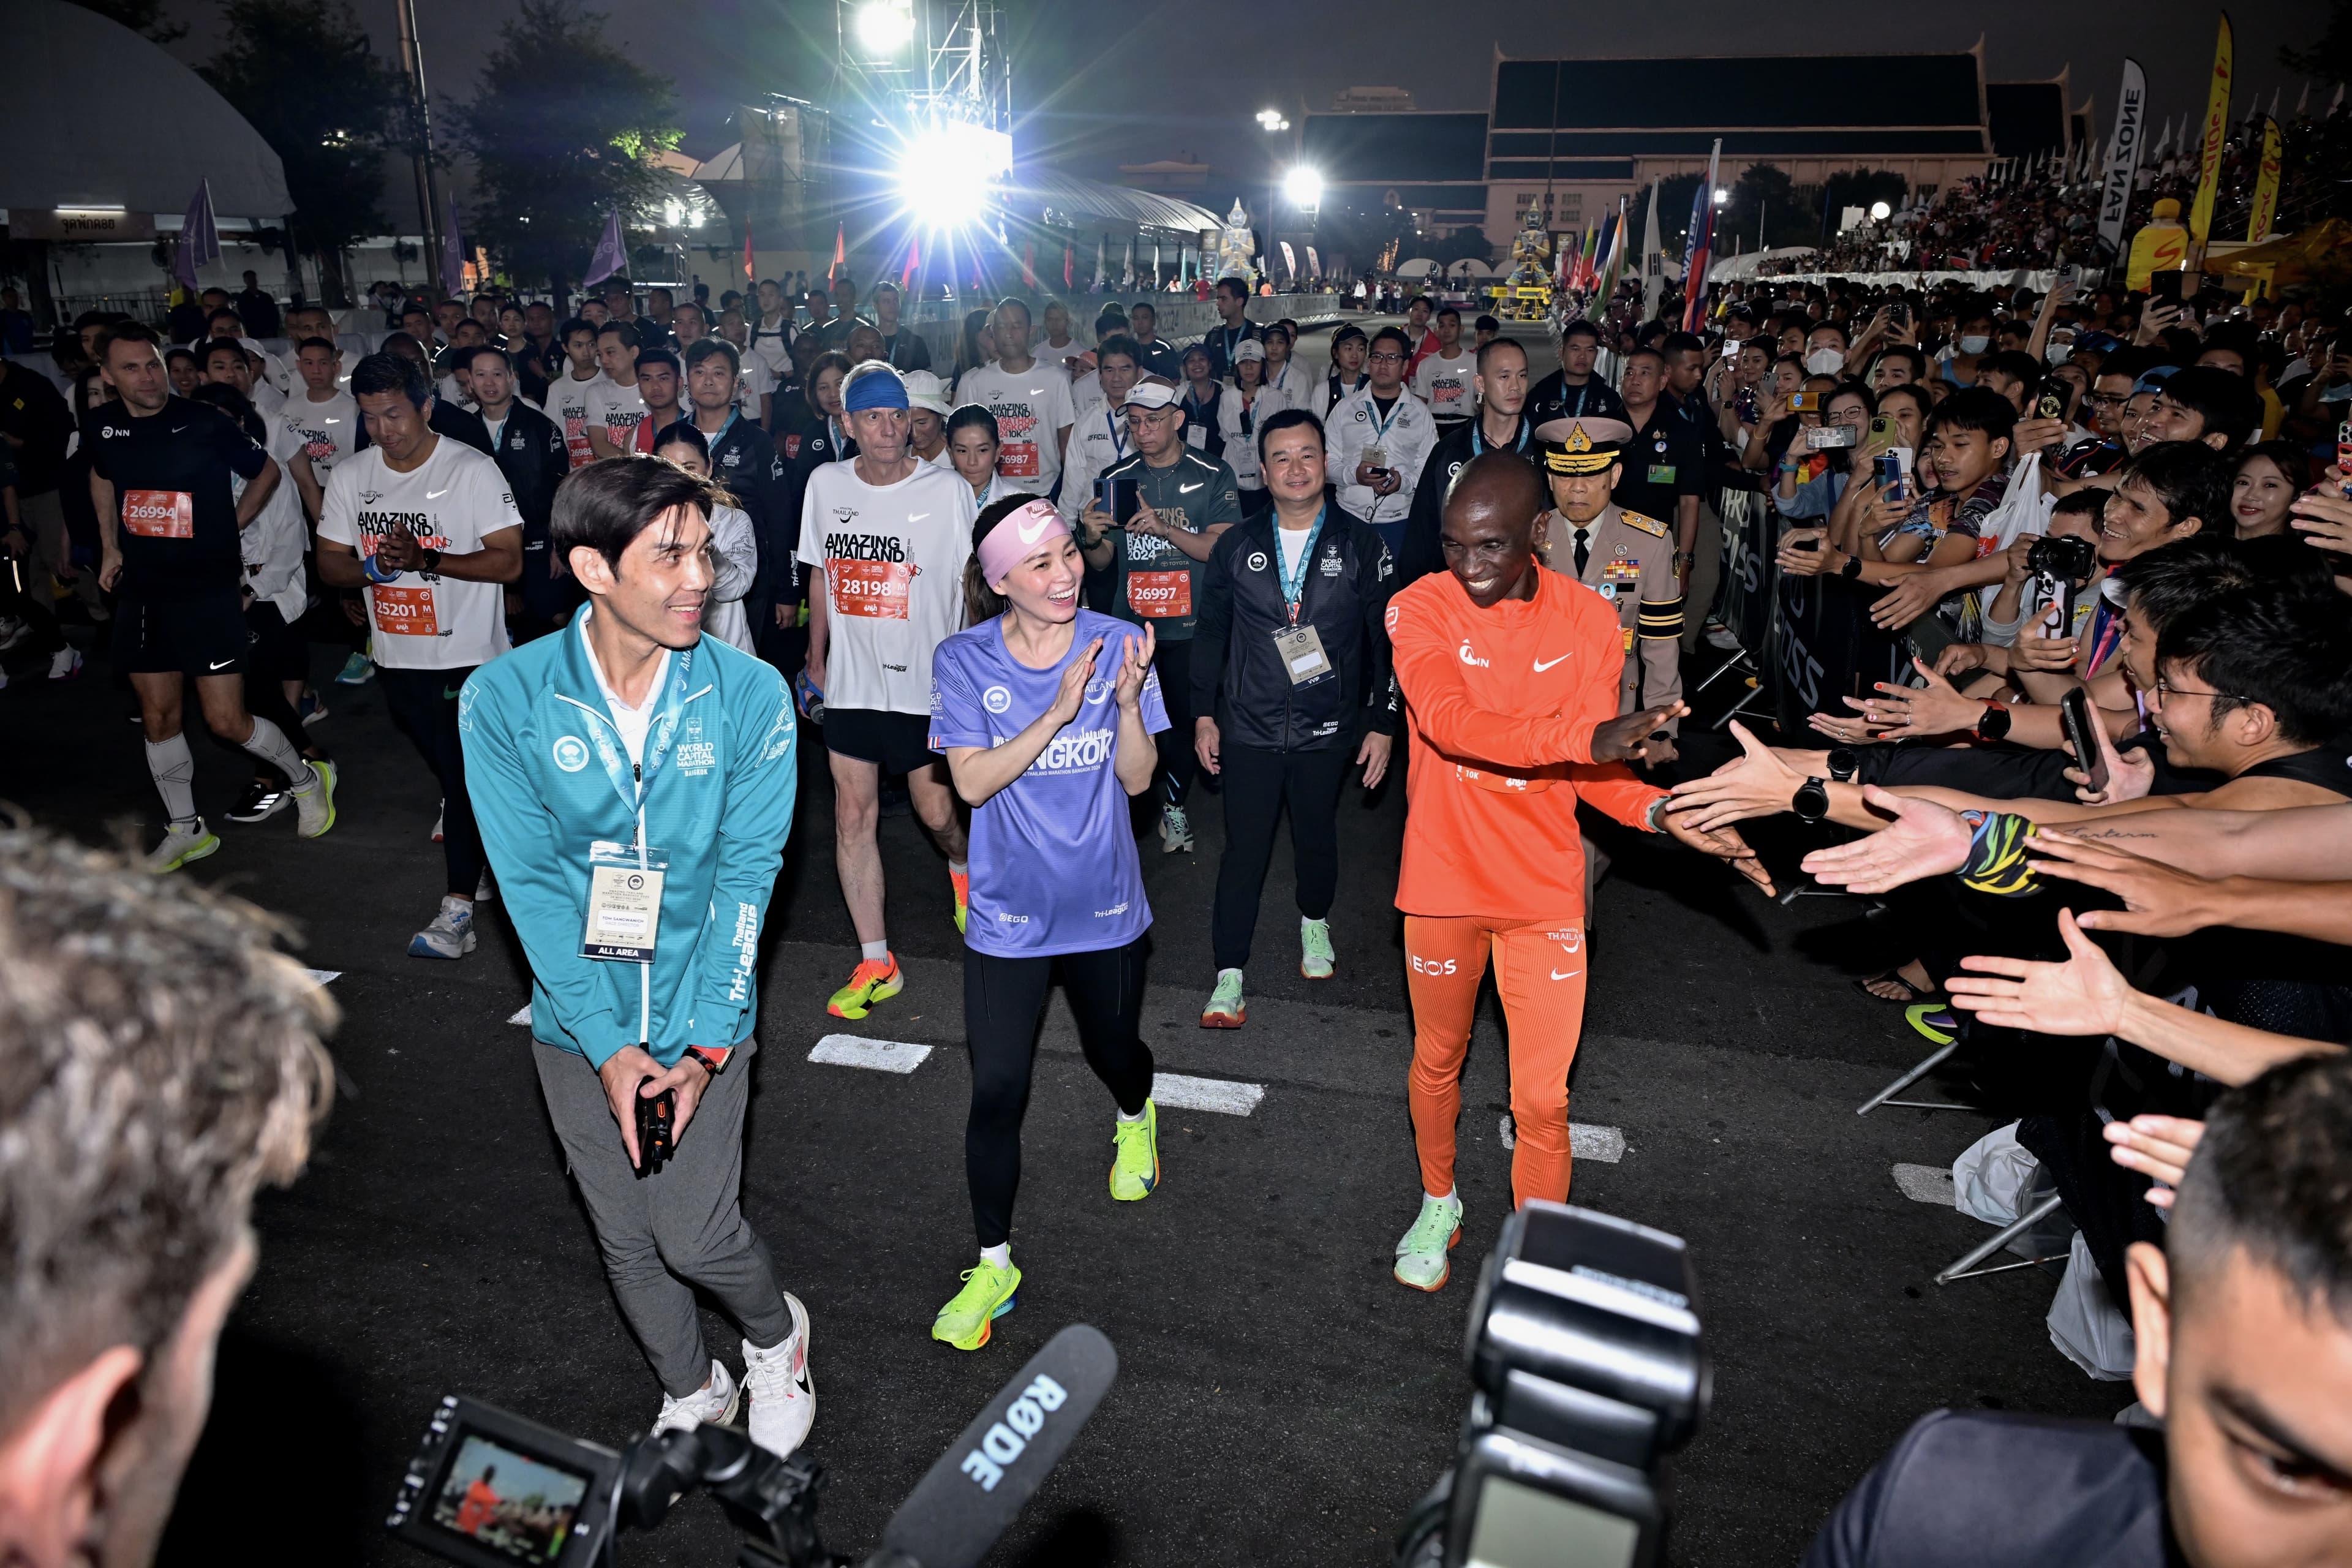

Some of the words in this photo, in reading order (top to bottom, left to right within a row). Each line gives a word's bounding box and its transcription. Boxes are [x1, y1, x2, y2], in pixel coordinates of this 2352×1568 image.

[563, 407, 585, 416] AMAZI
[989, 403, 1028, 412] AMAZING
[606, 412, 644, 422] AMAZING
[608, 418, 643, 427] THAILAN
[130, 505, 176, 519] 26994
[1031, 503, 1047, 513] NIKE
[1155, 507, 1185, 519] ZING
[358, 511, 428, 526] AMAZING
[825, 533, 900, 550] AMAZING
[1128, 538, 1176, 551] BANGK
[827, 545, 905, 564] THAILAND
[1128, 550, 1156, 561] 2024
[842, 579, 892, 597] 28198
[1135, 587, 1177, 600] 26997
[376, 600, 417, 617] 25201
[1308, 676, 1319, 684] VVIP
[656, 720, 673, 755] TOYOTA
[677, 742, 714, 753] WORLD
[1027, 735, 1114, 771] NGKOK
[677, 751, 714, 761] CAPITAL
[677, 758, 715, 767] MARATHON
[685, 768, 708, 777] BANGKOK
[1466, 770, 1479, 780] 10K
[1095, 904, 1128, 918] Tri-League
[732, 902, 748, 947] Thailand
[1547, 932, 1585, 941] THAILAN
[729, 904, 758, 1001] Tri-League
[1406, 947, 1457, 976] NEOS
[960, 1373, 1069, 1492] RØDE
